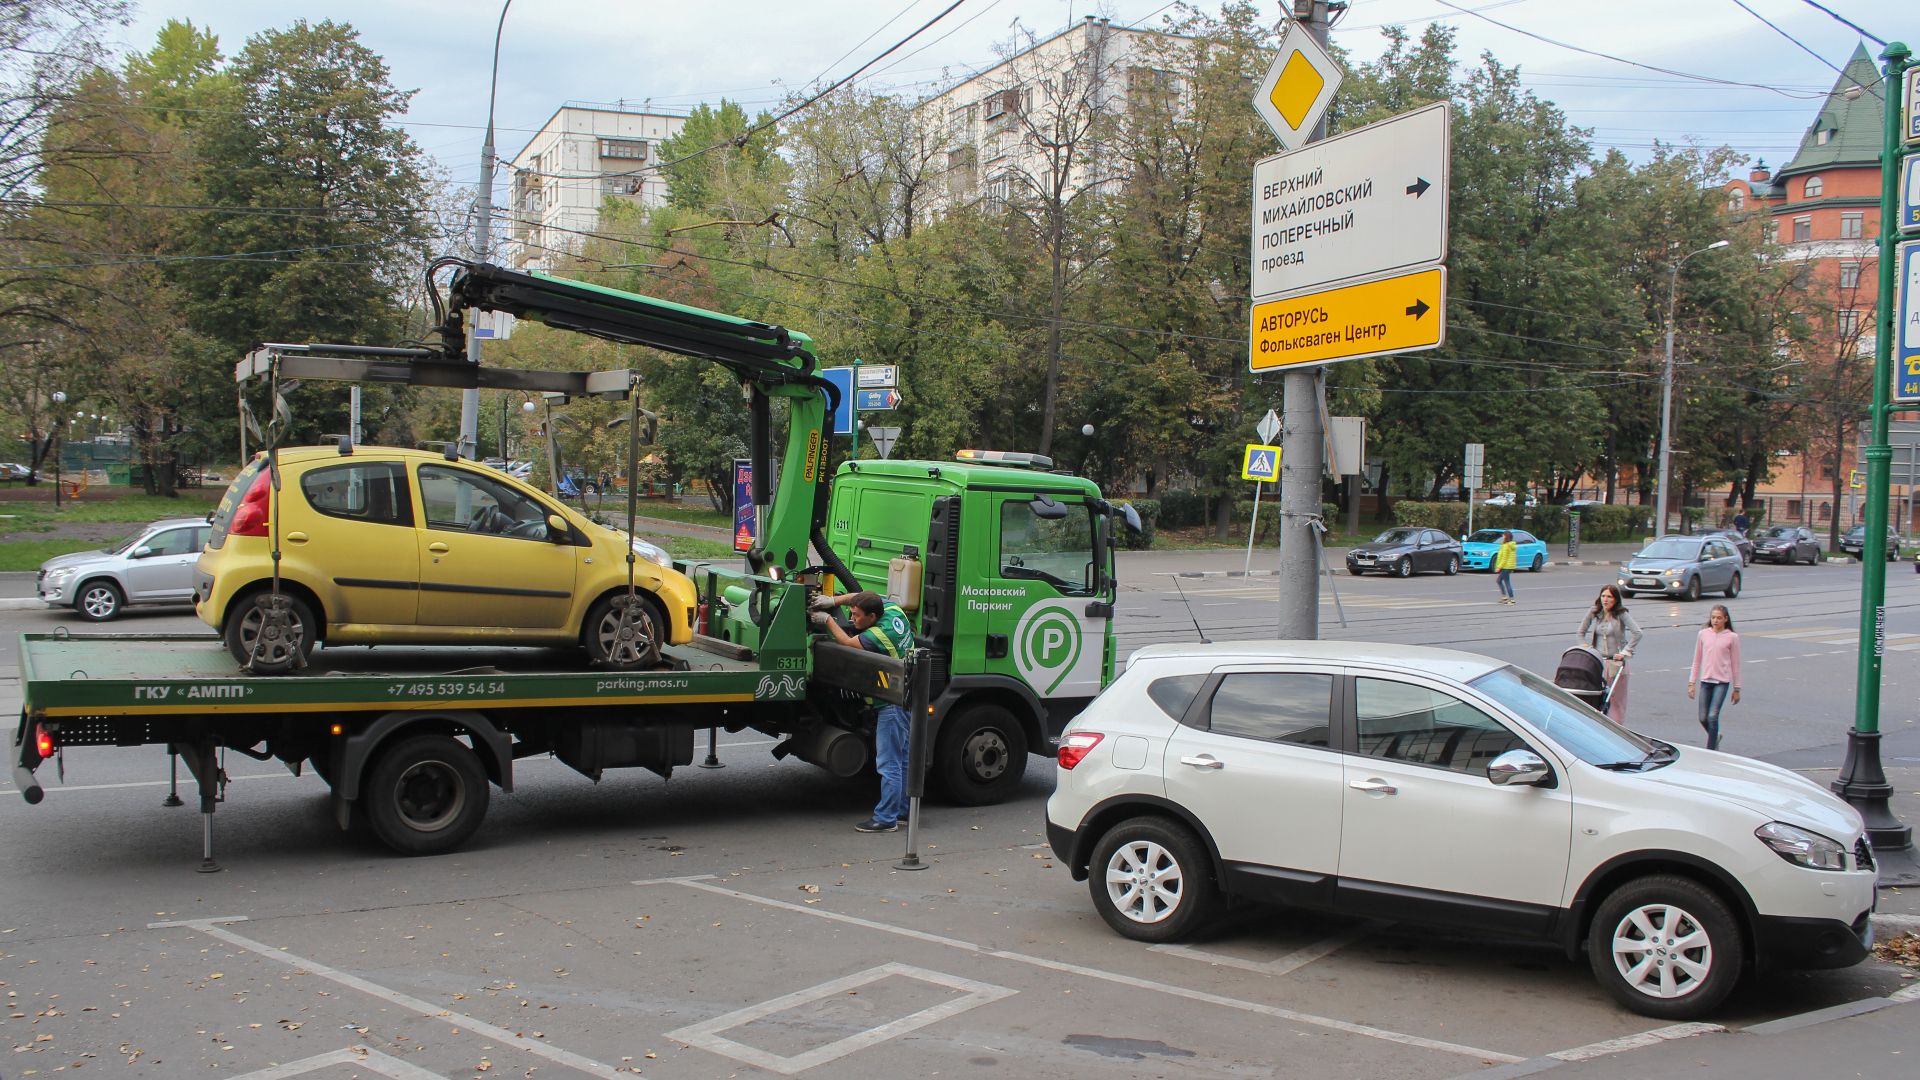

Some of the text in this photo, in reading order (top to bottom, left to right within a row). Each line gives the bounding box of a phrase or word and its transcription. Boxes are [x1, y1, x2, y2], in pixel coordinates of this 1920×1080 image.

[1263, 167, 1323, 200] ВЕРХНИЙ
[1262, 177, 1373, 225] МИХАЙЛОВСКИЙ
[1262, 208, 1354, 250] ПОПЕРЕЧНЫЙ
[1261, 251, 1304, 273] проезд
[1260, 306, 1329, 332] АВТОРУСЬ
[1260, 323, 1387, 354] Фольксваген Центр
[805, 432, 818, 479] PALFINGER
[961, 584, 1026, 597] Московский
[967, 599, 1013, 614] Паркинг
[778, 657, 805, 669] 6311
[134, 686, 171, 699] ГКУ
[387, 682, 505, 695] +7 495 539 54 54
[596, 678, 689, 692] parking.mos.ru
